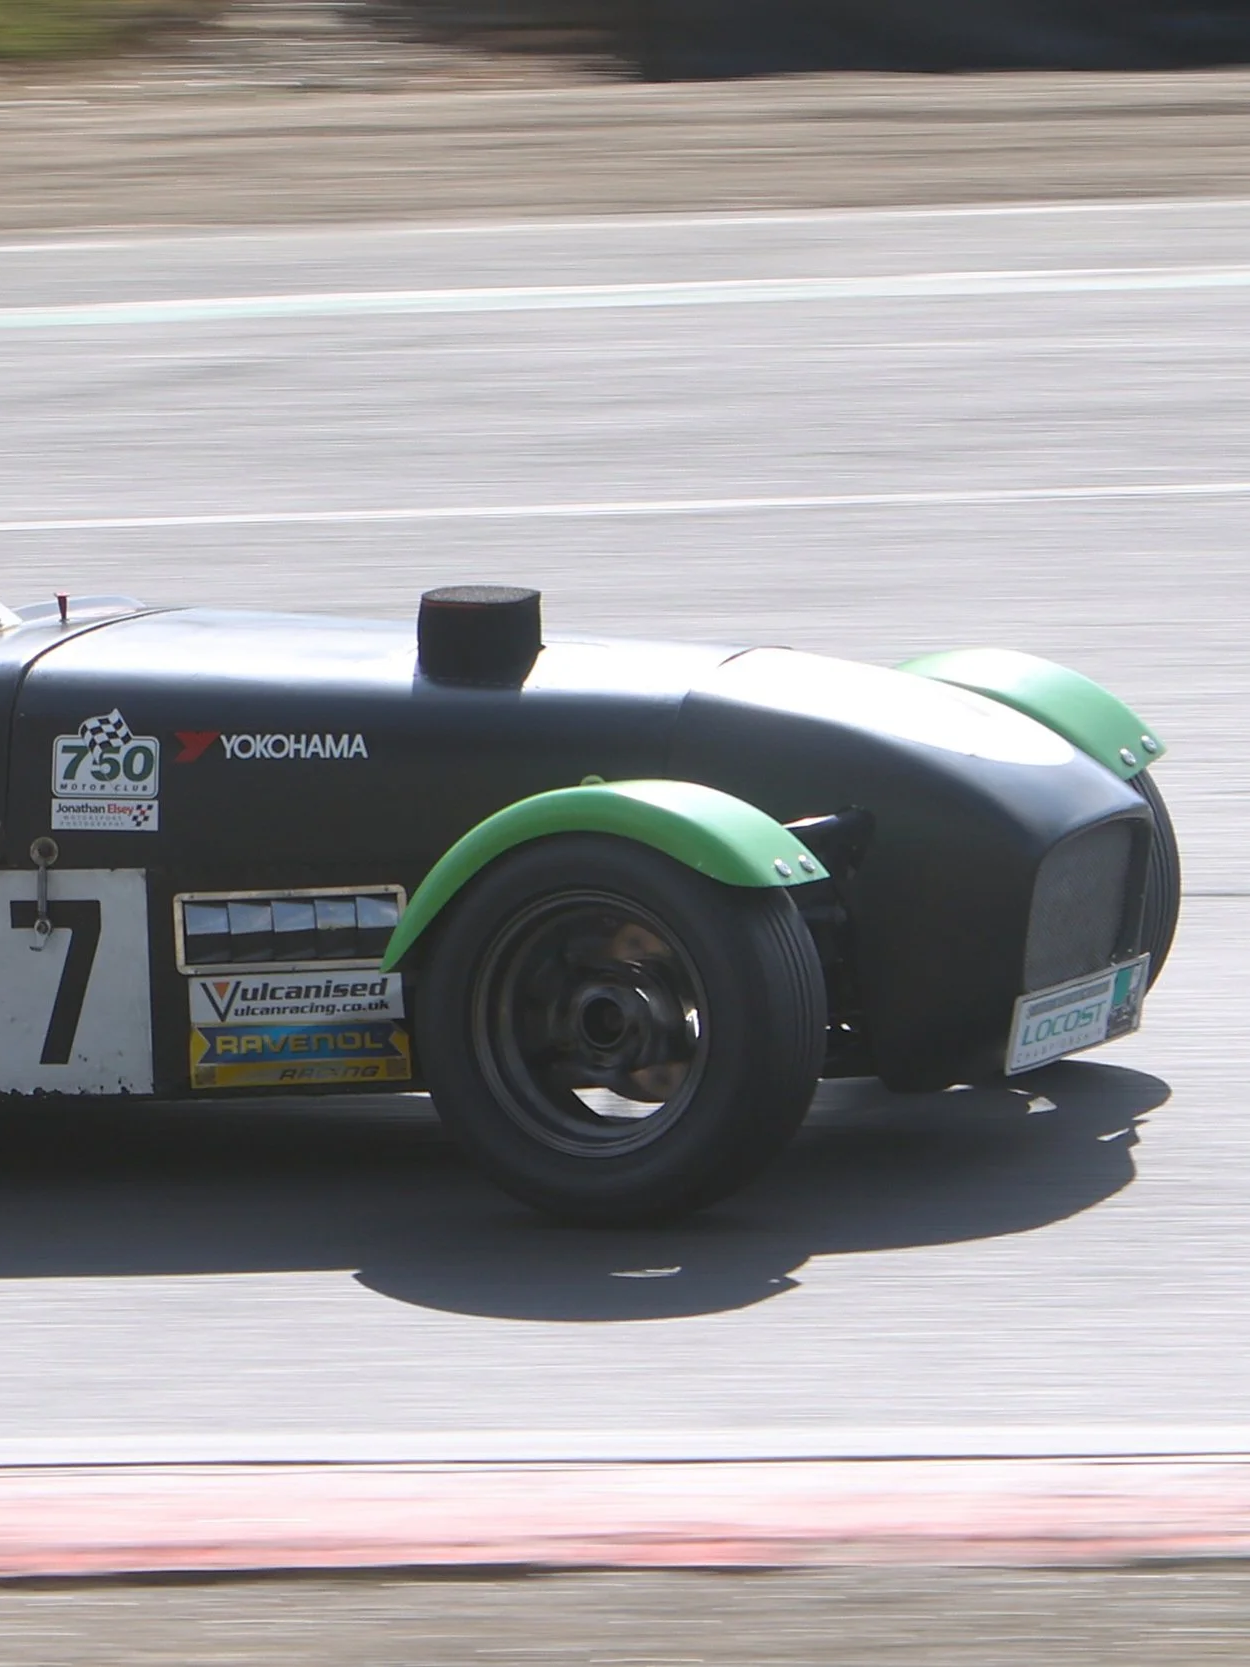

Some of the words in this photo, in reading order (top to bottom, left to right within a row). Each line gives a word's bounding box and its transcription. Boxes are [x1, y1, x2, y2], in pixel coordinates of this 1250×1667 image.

[220, 734, 368, 759] YOKOHAMA
[61, 745, 154, 782] 750
[60, 783, 105, 791] MOTOR
[114, 784, 148, 792] CLUB
[56, 803, 105, 814] Jonathan
[107, 804, 133, 817] Elsey
[200, 977, 388, 1021] Vulcanised
[1021, 1000, 1108, 1046] LOCOST
[215, 1031, 383, 1055] RAVENOL
